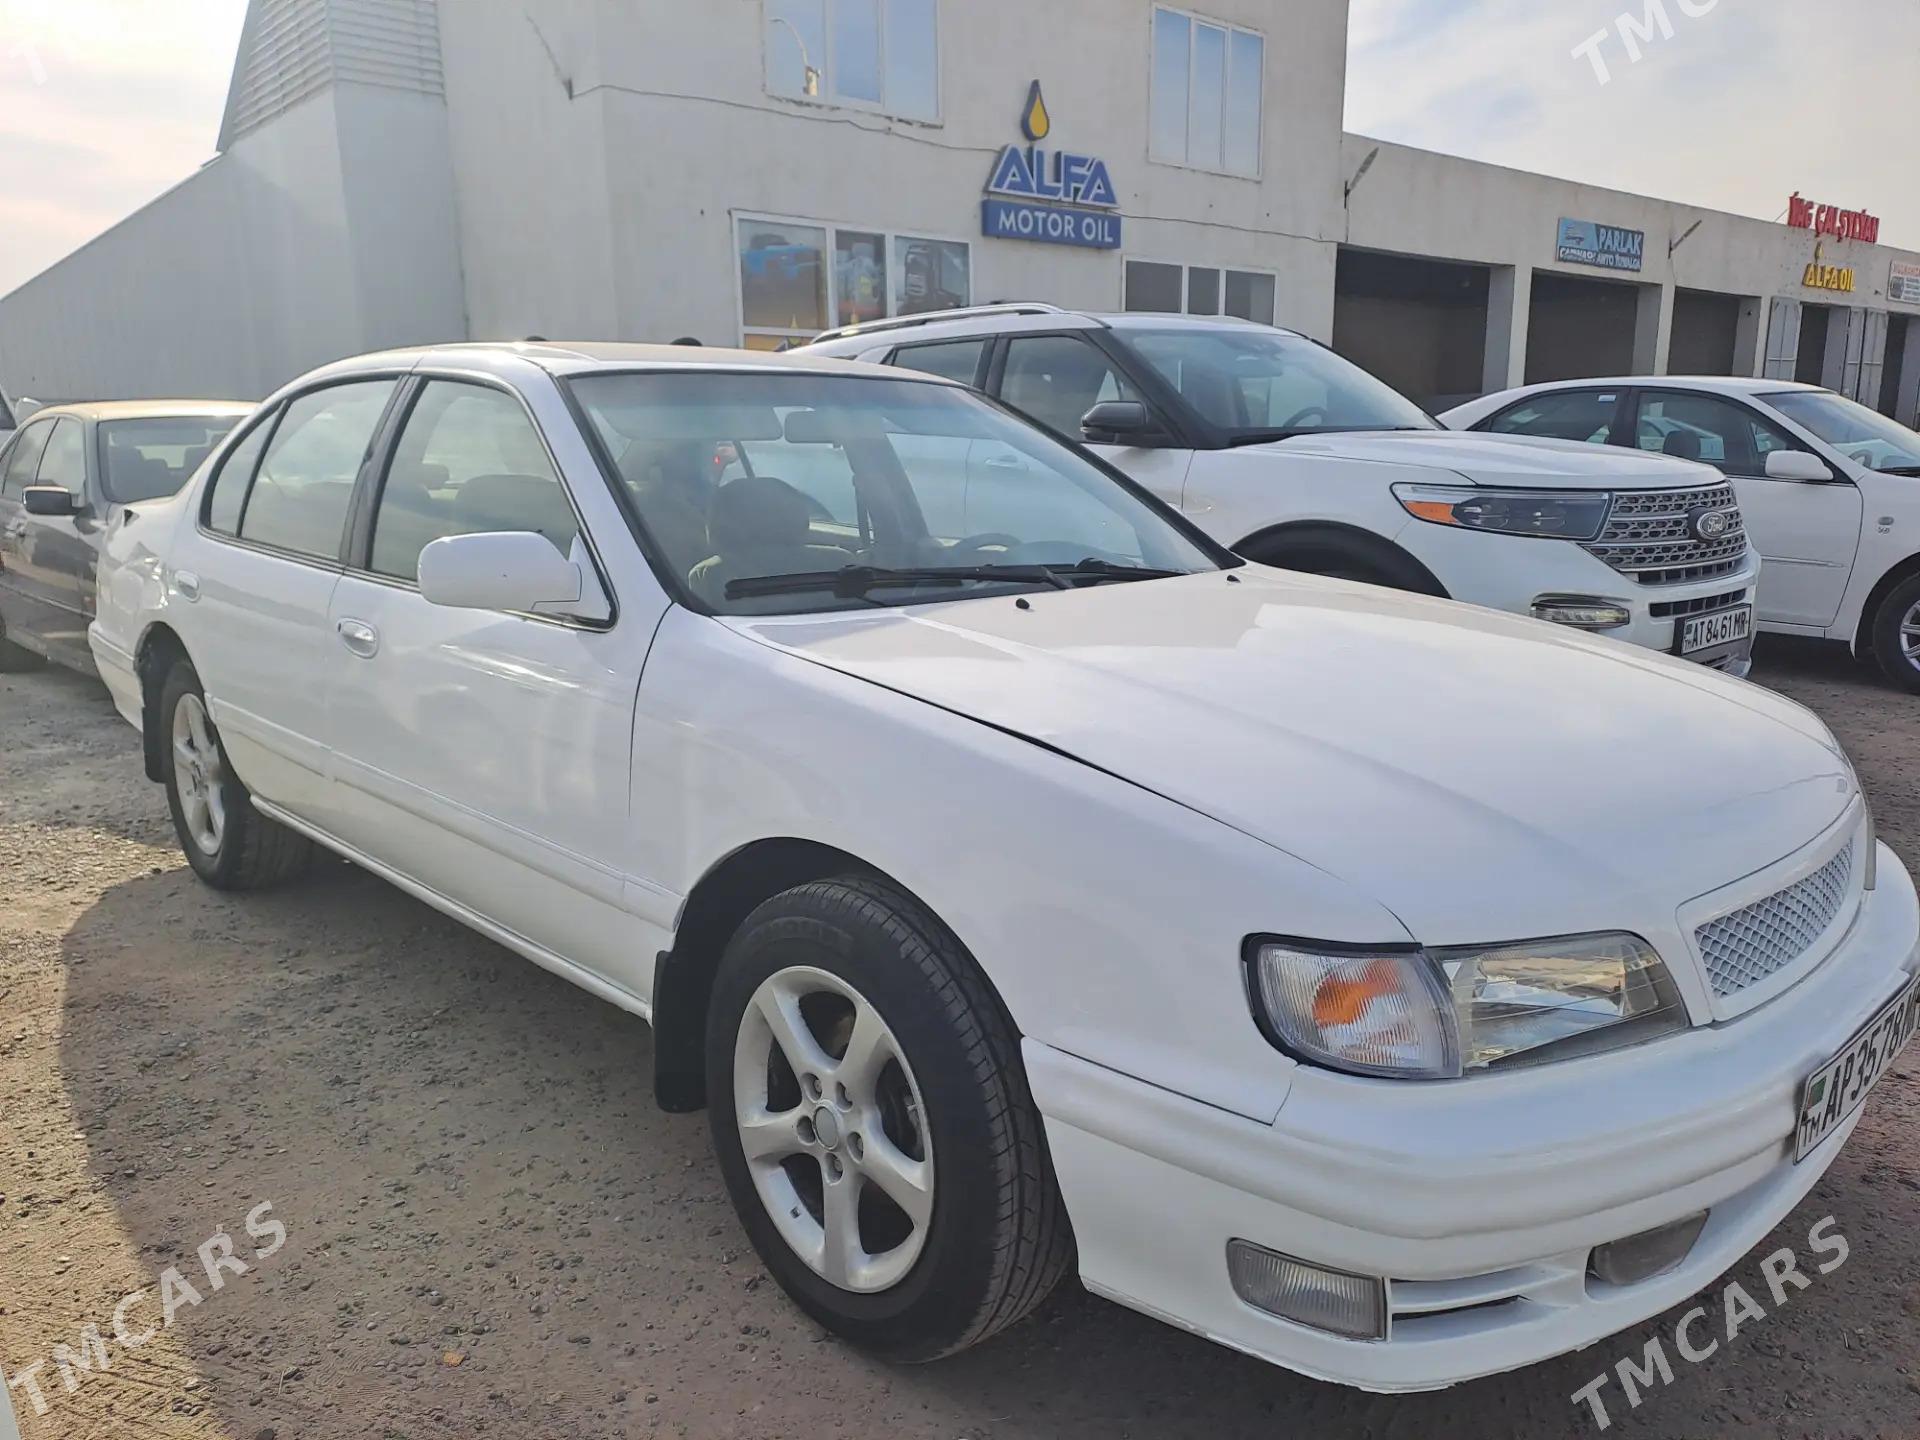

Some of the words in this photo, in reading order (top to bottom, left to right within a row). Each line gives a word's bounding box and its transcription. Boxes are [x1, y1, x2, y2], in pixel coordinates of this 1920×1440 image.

[988, 144, 1119, 208] ALFA
[999, 209, 1075, 239] MOTOR
[1082, 217, 1113, 243] OIL
[1600, 227, 1643, 255] PARLAK
[1803, 263, 1839, 290] ALFA
[1840, 267, 1856, 292] OIL
[1801, 1112, 1822, 1147] TM
